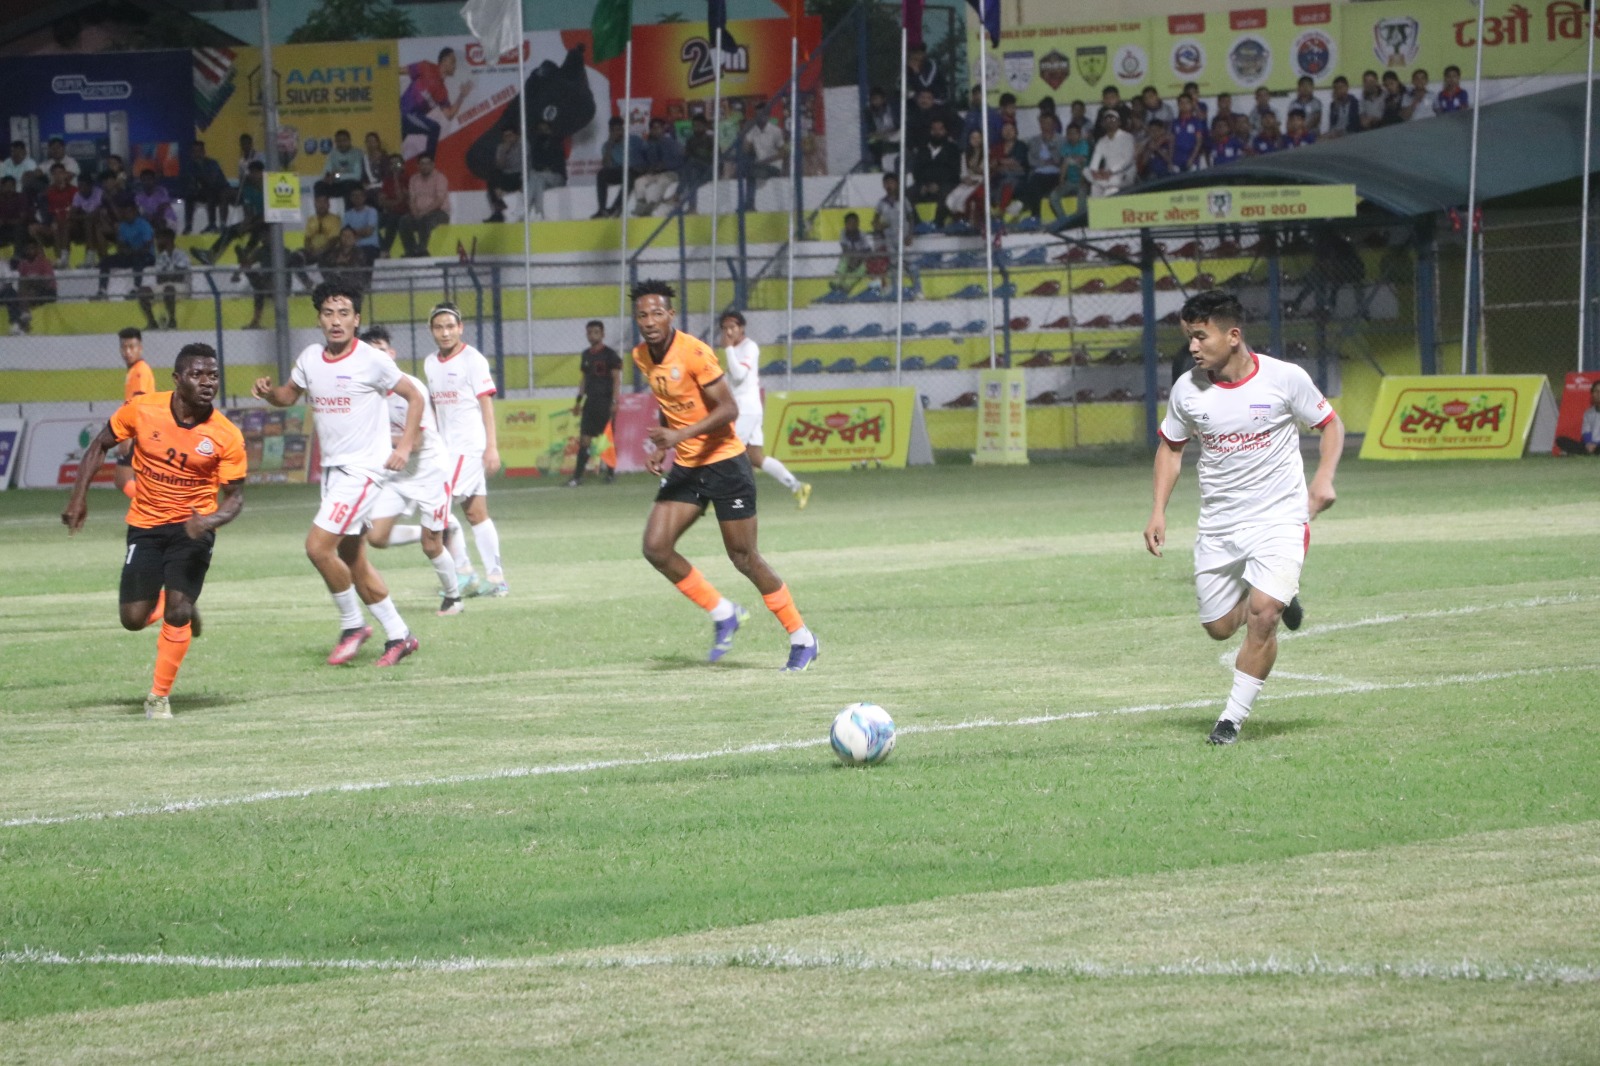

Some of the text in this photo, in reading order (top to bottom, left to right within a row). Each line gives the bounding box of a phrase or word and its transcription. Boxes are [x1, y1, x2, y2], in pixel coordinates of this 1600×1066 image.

[1120, 22, 1141, 32] TEAM
[286, 67, 373, 84] AARTI
[286, 85, 373, 104] SILVER SHINE
[315, 396, 351, 406] POWER
[1218, 429, 1271, 444] POWER
[166, 447, 188, 471] 21
[328, 501, 350, 524] 16
